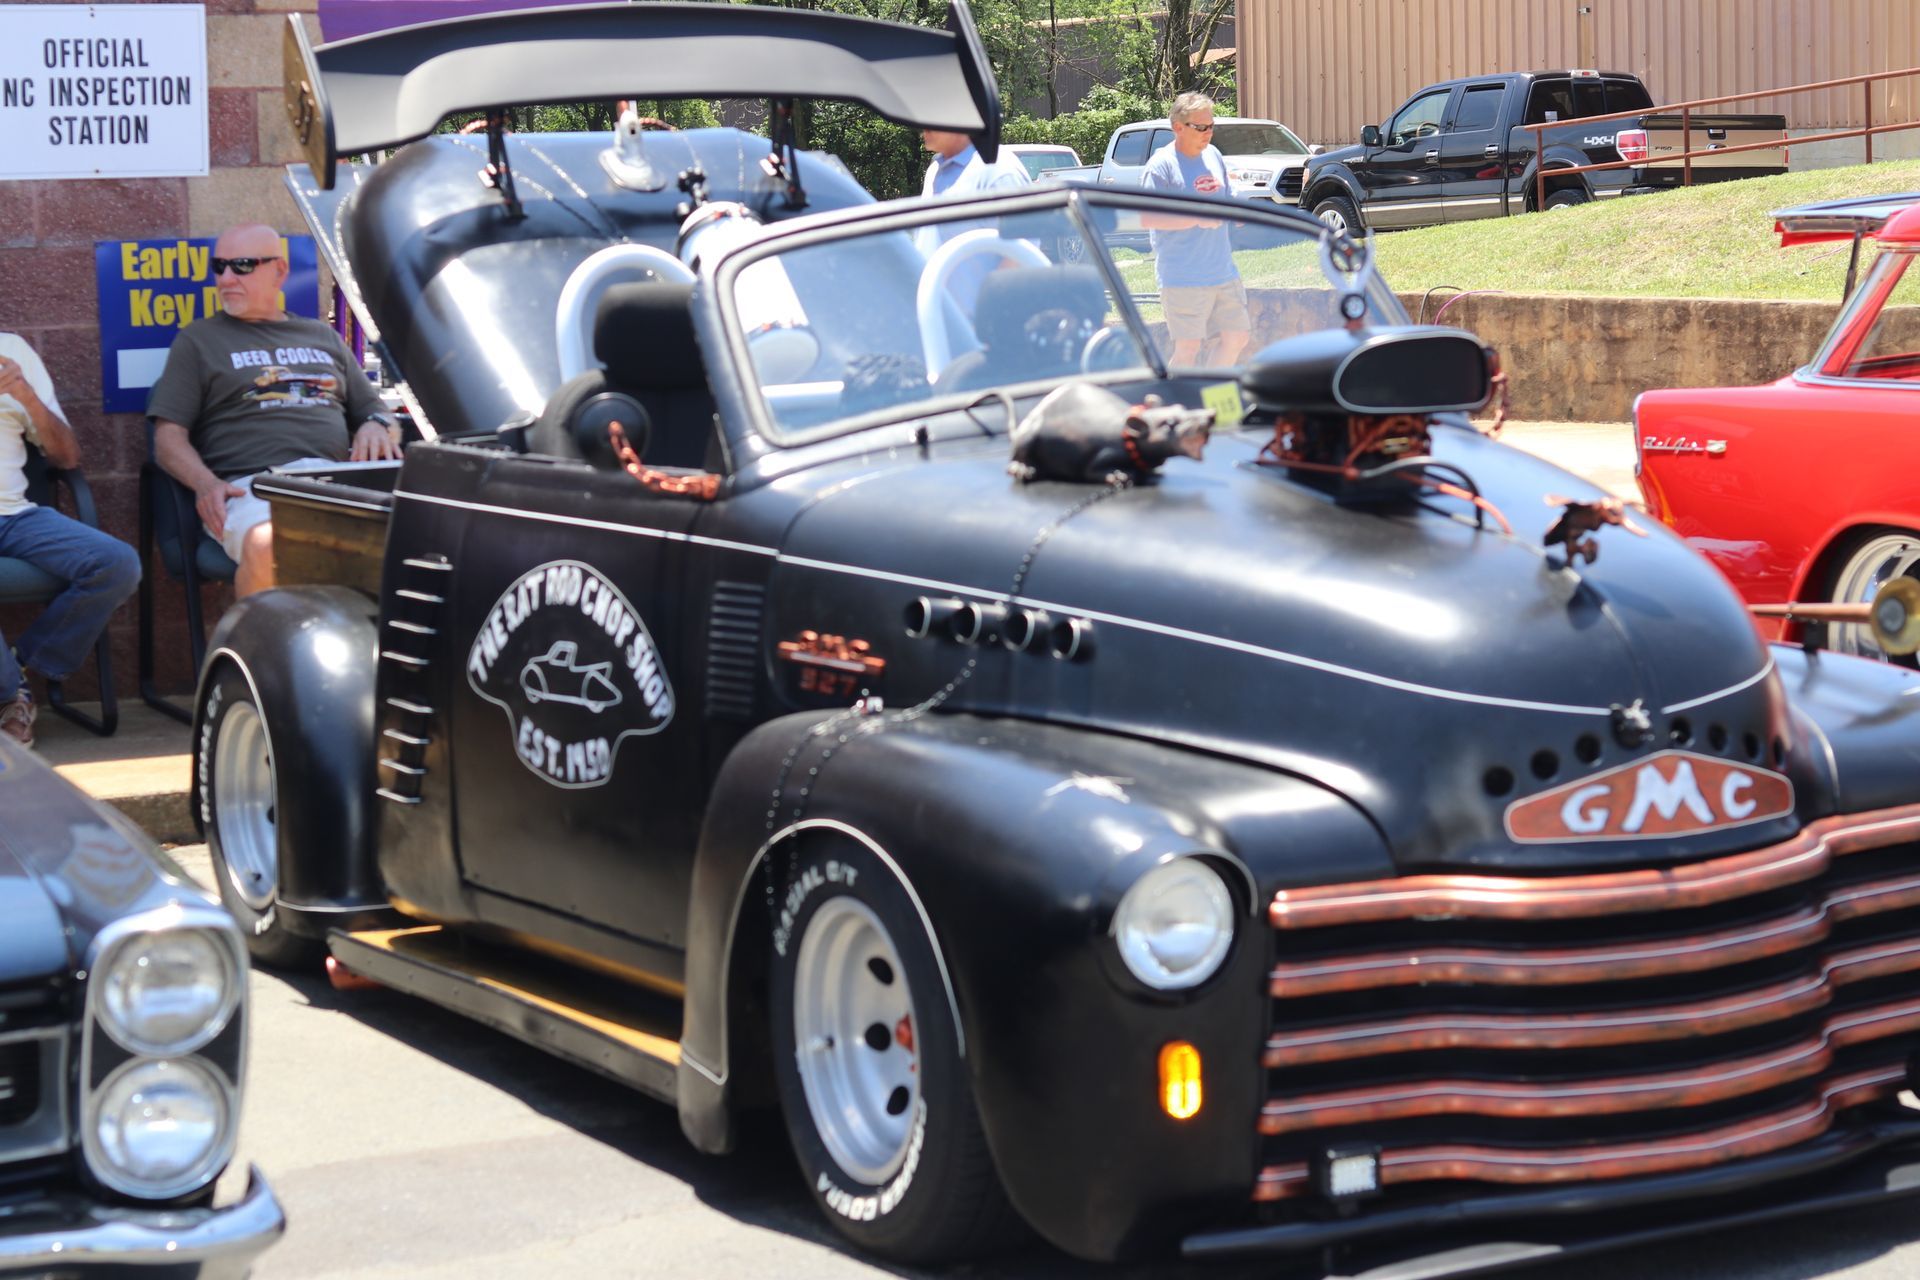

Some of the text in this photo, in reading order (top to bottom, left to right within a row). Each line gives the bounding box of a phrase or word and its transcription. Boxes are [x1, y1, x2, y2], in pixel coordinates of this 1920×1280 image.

[43, 38, 149, 68] OFFICIAL
[3, 76, 191, 107] NC INSPECTION
[49, 115, 148, 145] STATION
[121, 241, 209, 281] Early
[130, 288, 195, 329] Key
[231, 350, 273, 369] BEER
[469, 565, 673, 718] THE RAT ROD CHOP SHOP
[518, 715, 564, 778] EST.
[1561, 759, 1757, 834] GMC
